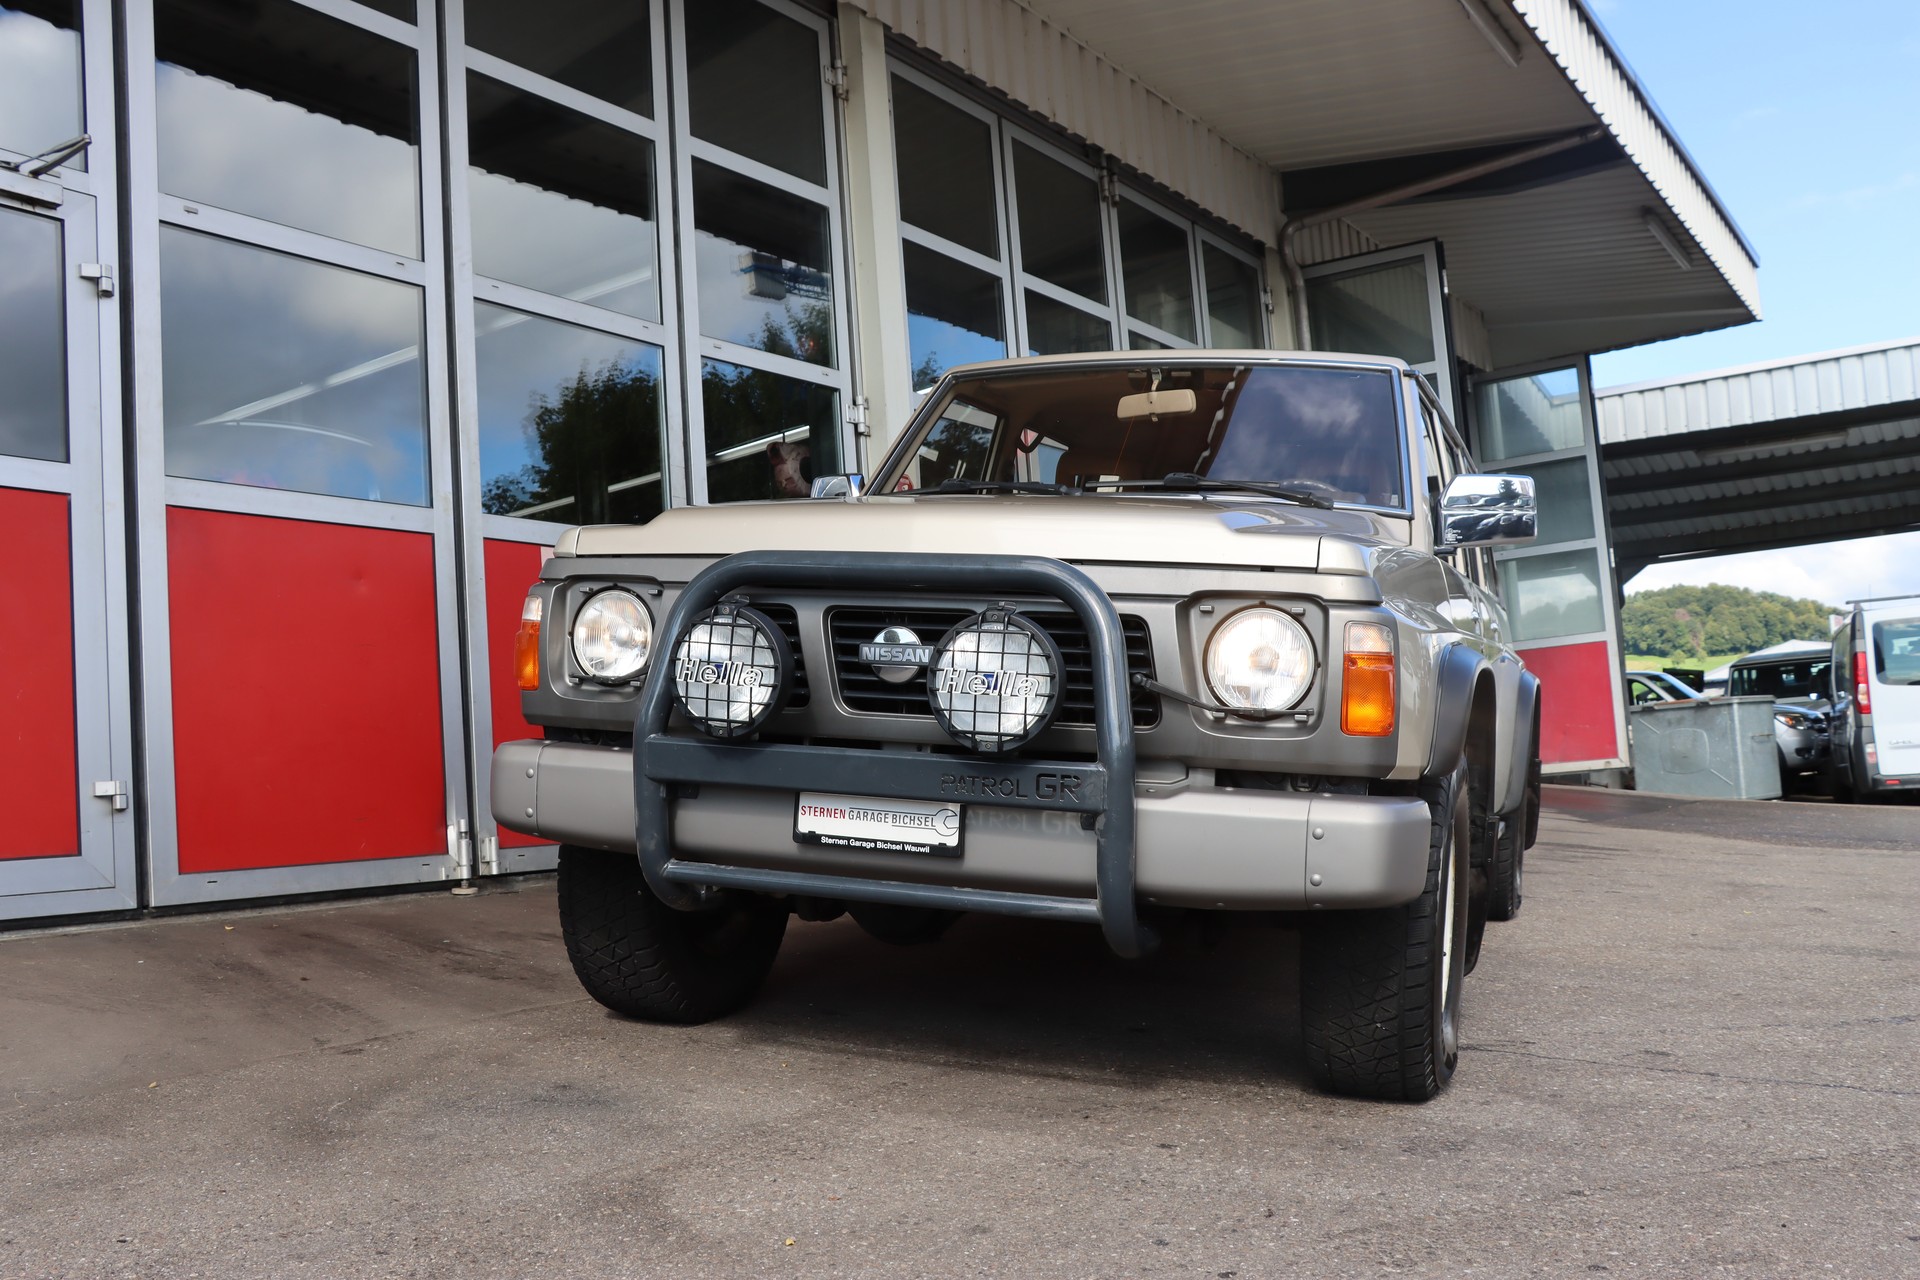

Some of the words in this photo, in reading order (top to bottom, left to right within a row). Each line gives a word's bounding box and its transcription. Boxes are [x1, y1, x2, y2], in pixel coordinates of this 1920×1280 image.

[862, 646, 929, 663] NISSAN
[676, 656, 764, 688] Hella
[938, 667, 1040, 698] Hella
[940, 773, 1028, 800] PATROL
[1035, 773, 1082, 803] GR
[800, 805, 846, 820] STERNEN
[848, 809, 889, 824] GARAGE
[891, 812, 936, 828] BICHSEL
[821, 836, 849, 846] Sternen
[849, 838, 875, 849] Garage
[876, 841, 903, 851] Bichsel
[904, 843, 930, 854] Wauwil
